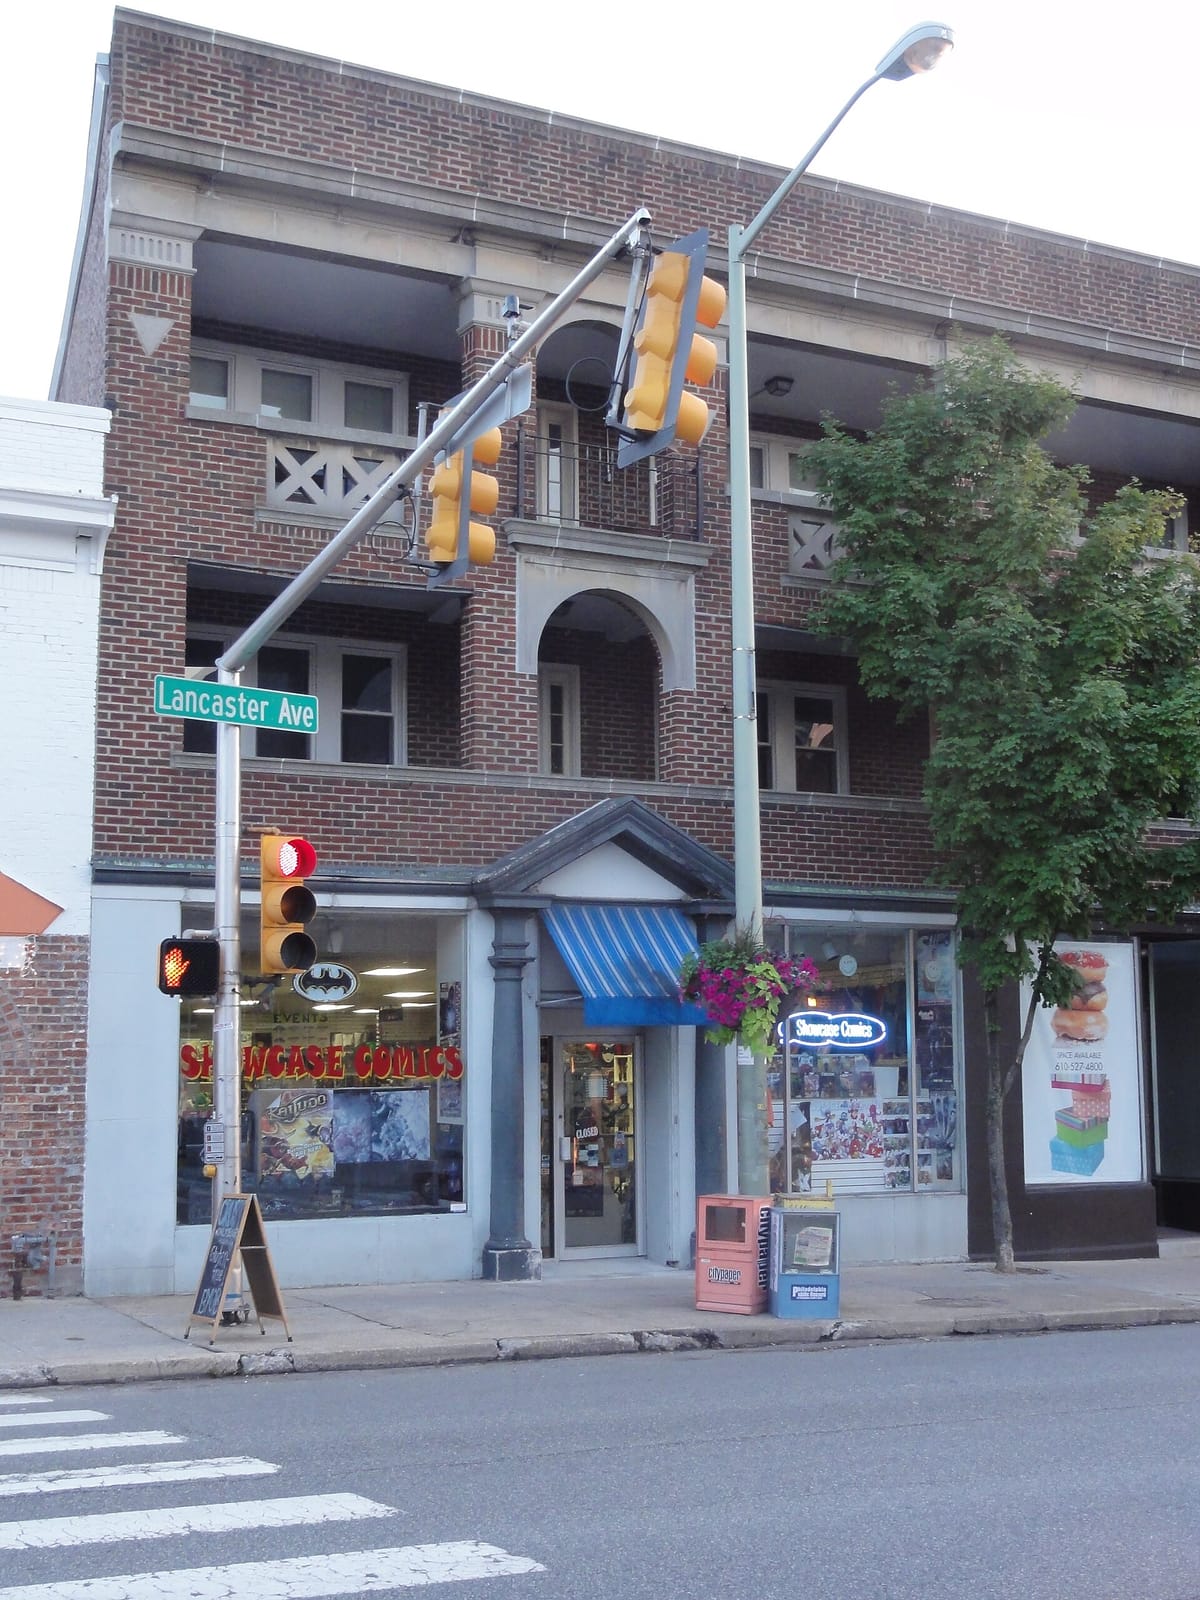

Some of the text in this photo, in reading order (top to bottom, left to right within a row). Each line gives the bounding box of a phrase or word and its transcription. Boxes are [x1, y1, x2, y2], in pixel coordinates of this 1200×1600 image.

[158, 681, 314, 727] Lancaster Ave
[796, 1019, 872, 1037] Showcase Comics
[181, 1043, 464, 1081] SHWCASE COMICS
[1055, 1062, 1103, 1071] 610-527-4800
[576, 1126, 599, 1139] CLOSED
[708, 1266, 742, 1281] citypaper
